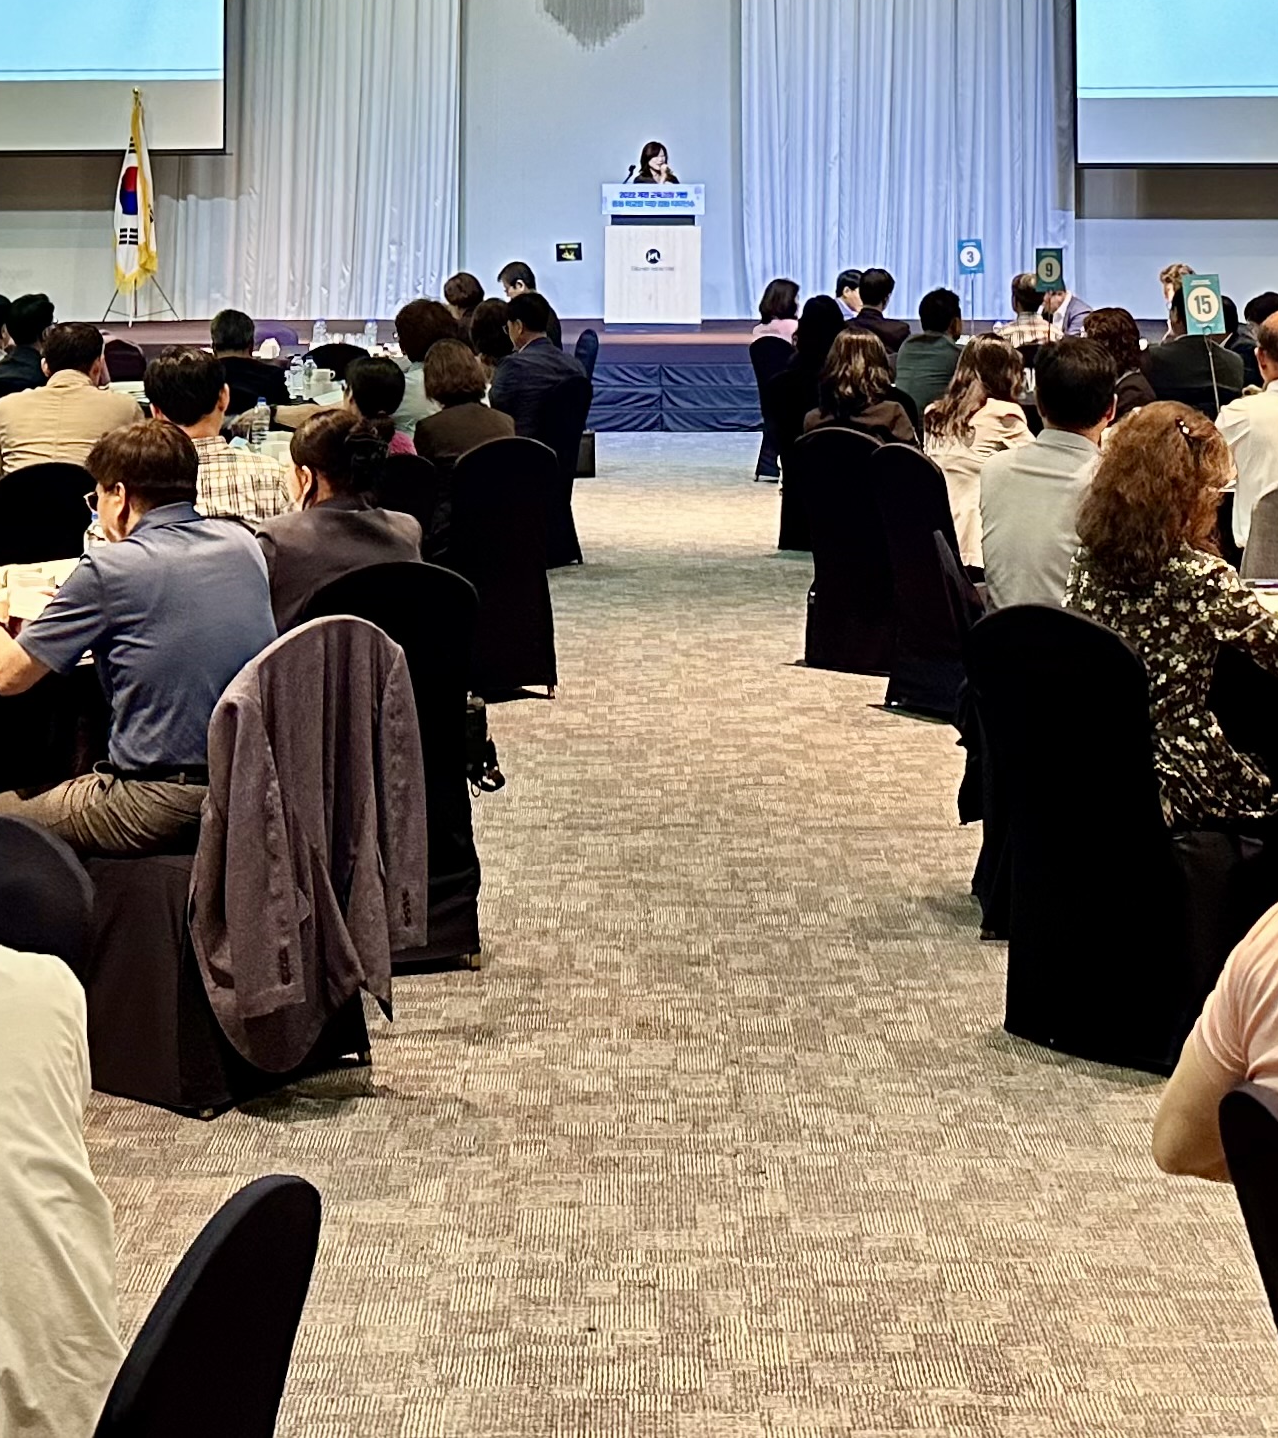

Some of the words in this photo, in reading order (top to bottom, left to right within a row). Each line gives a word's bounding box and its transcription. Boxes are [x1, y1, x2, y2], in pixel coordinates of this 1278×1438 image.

[966, 250, 975, 263] 3
[1045, 263, 1053, 278] 9
[1194, 294, 1213, 315] 15
